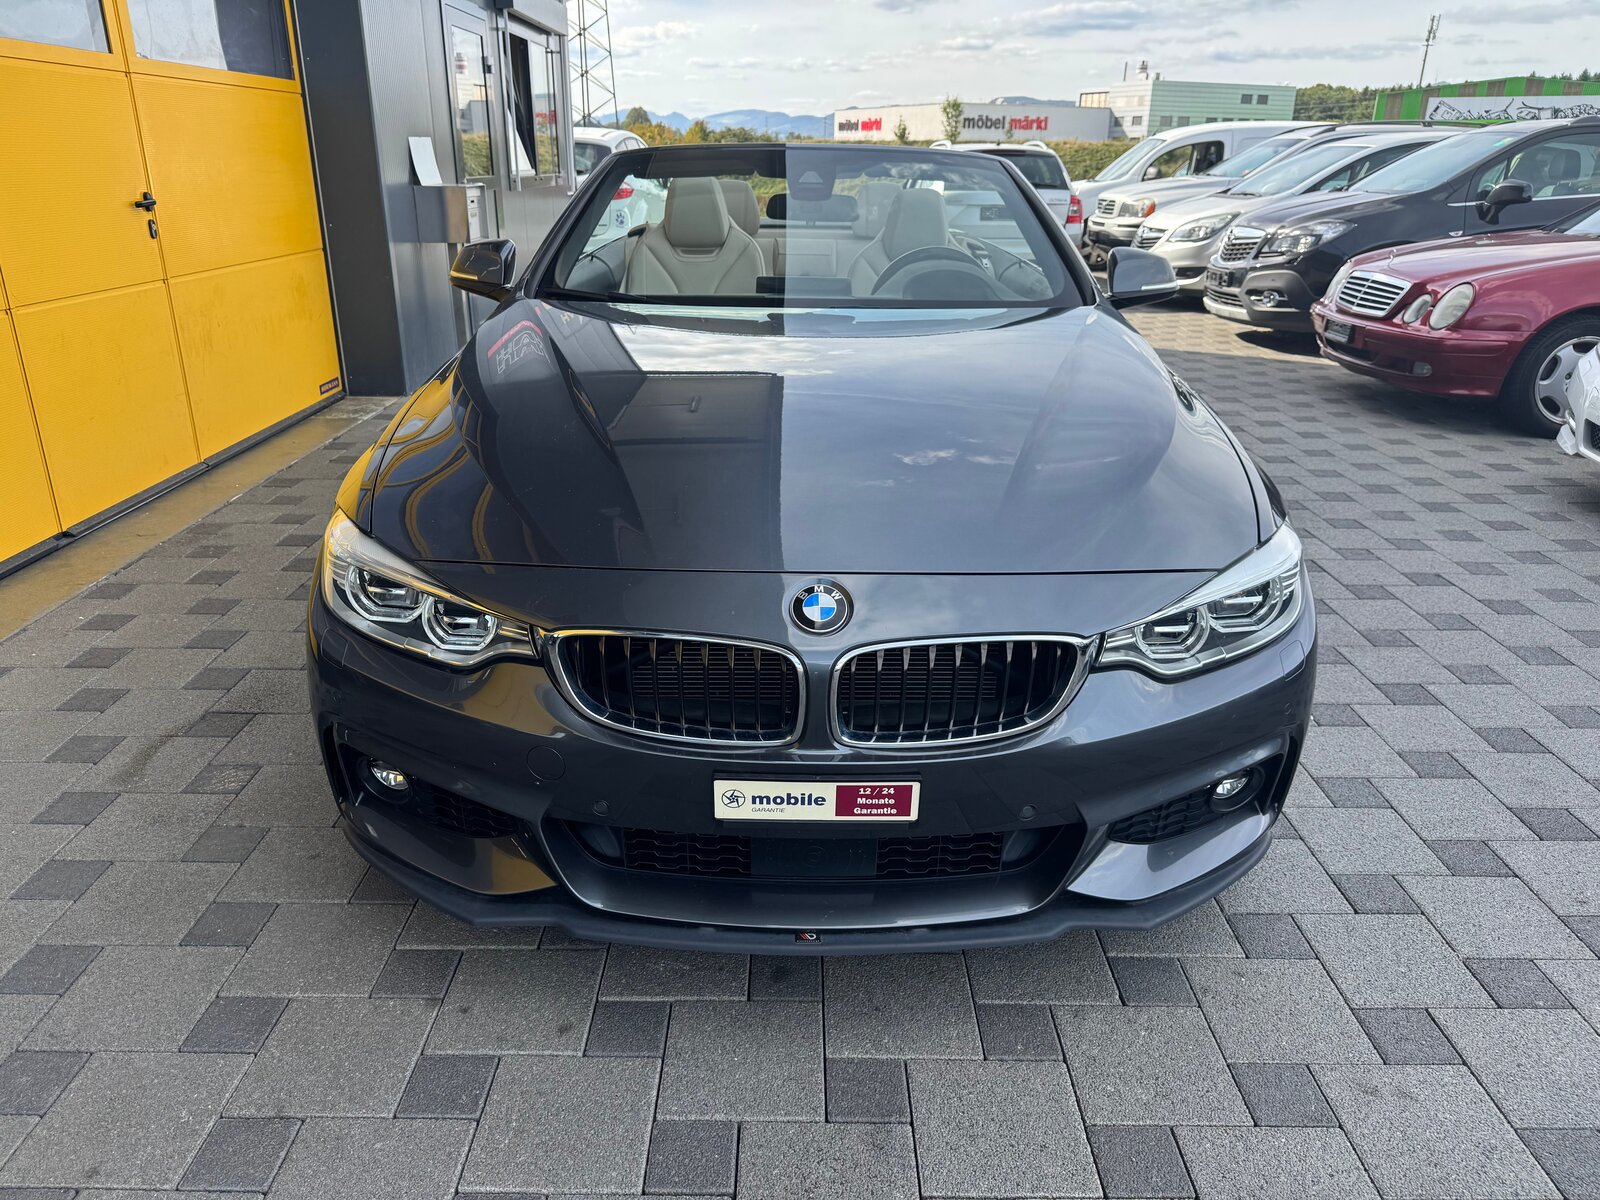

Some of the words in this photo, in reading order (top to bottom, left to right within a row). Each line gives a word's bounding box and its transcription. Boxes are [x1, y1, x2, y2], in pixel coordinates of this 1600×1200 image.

[963, 115, 1006, 129] möbel
[798, 585, 842, 600] BMW
[858, 787, 871, 795] 12
[881, 787, 895, 795] 24
[751, 792, 827, 806] mobile
[857, 797, 895, 805] Monate
[853, 807, 897, 815] Garantie
